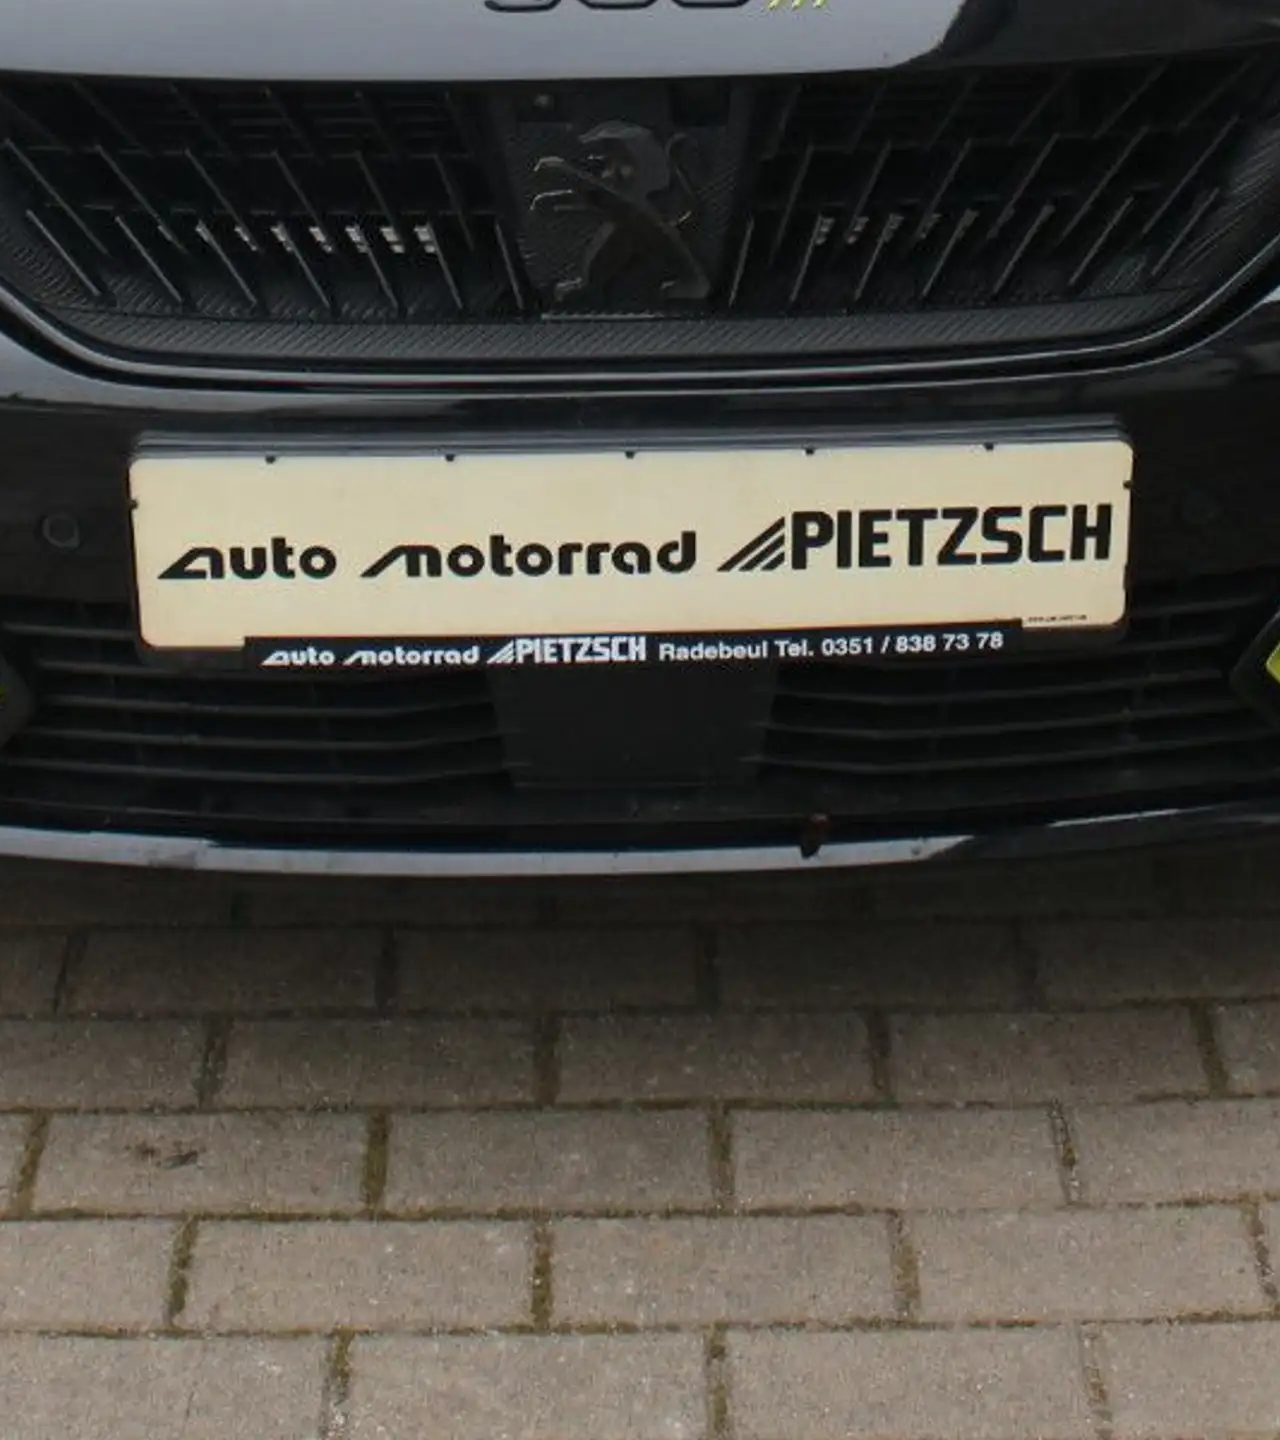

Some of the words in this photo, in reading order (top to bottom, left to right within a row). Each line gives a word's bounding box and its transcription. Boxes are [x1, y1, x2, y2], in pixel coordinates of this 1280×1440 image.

[791, 503, 1113, 570] PIETZSCH
[515, 636, 647, 664] PIETZSCH
[659, 640, 769, 660] Radebeul
[775, 639, 814, 658] Tel.
[822, 637, 872, 656] 0351
[880, 635, 890, 655] /
[895, 634, 936, 654] 838
[943, 633, 970, 652] 73
[976, 631, 1004, 650] 78
